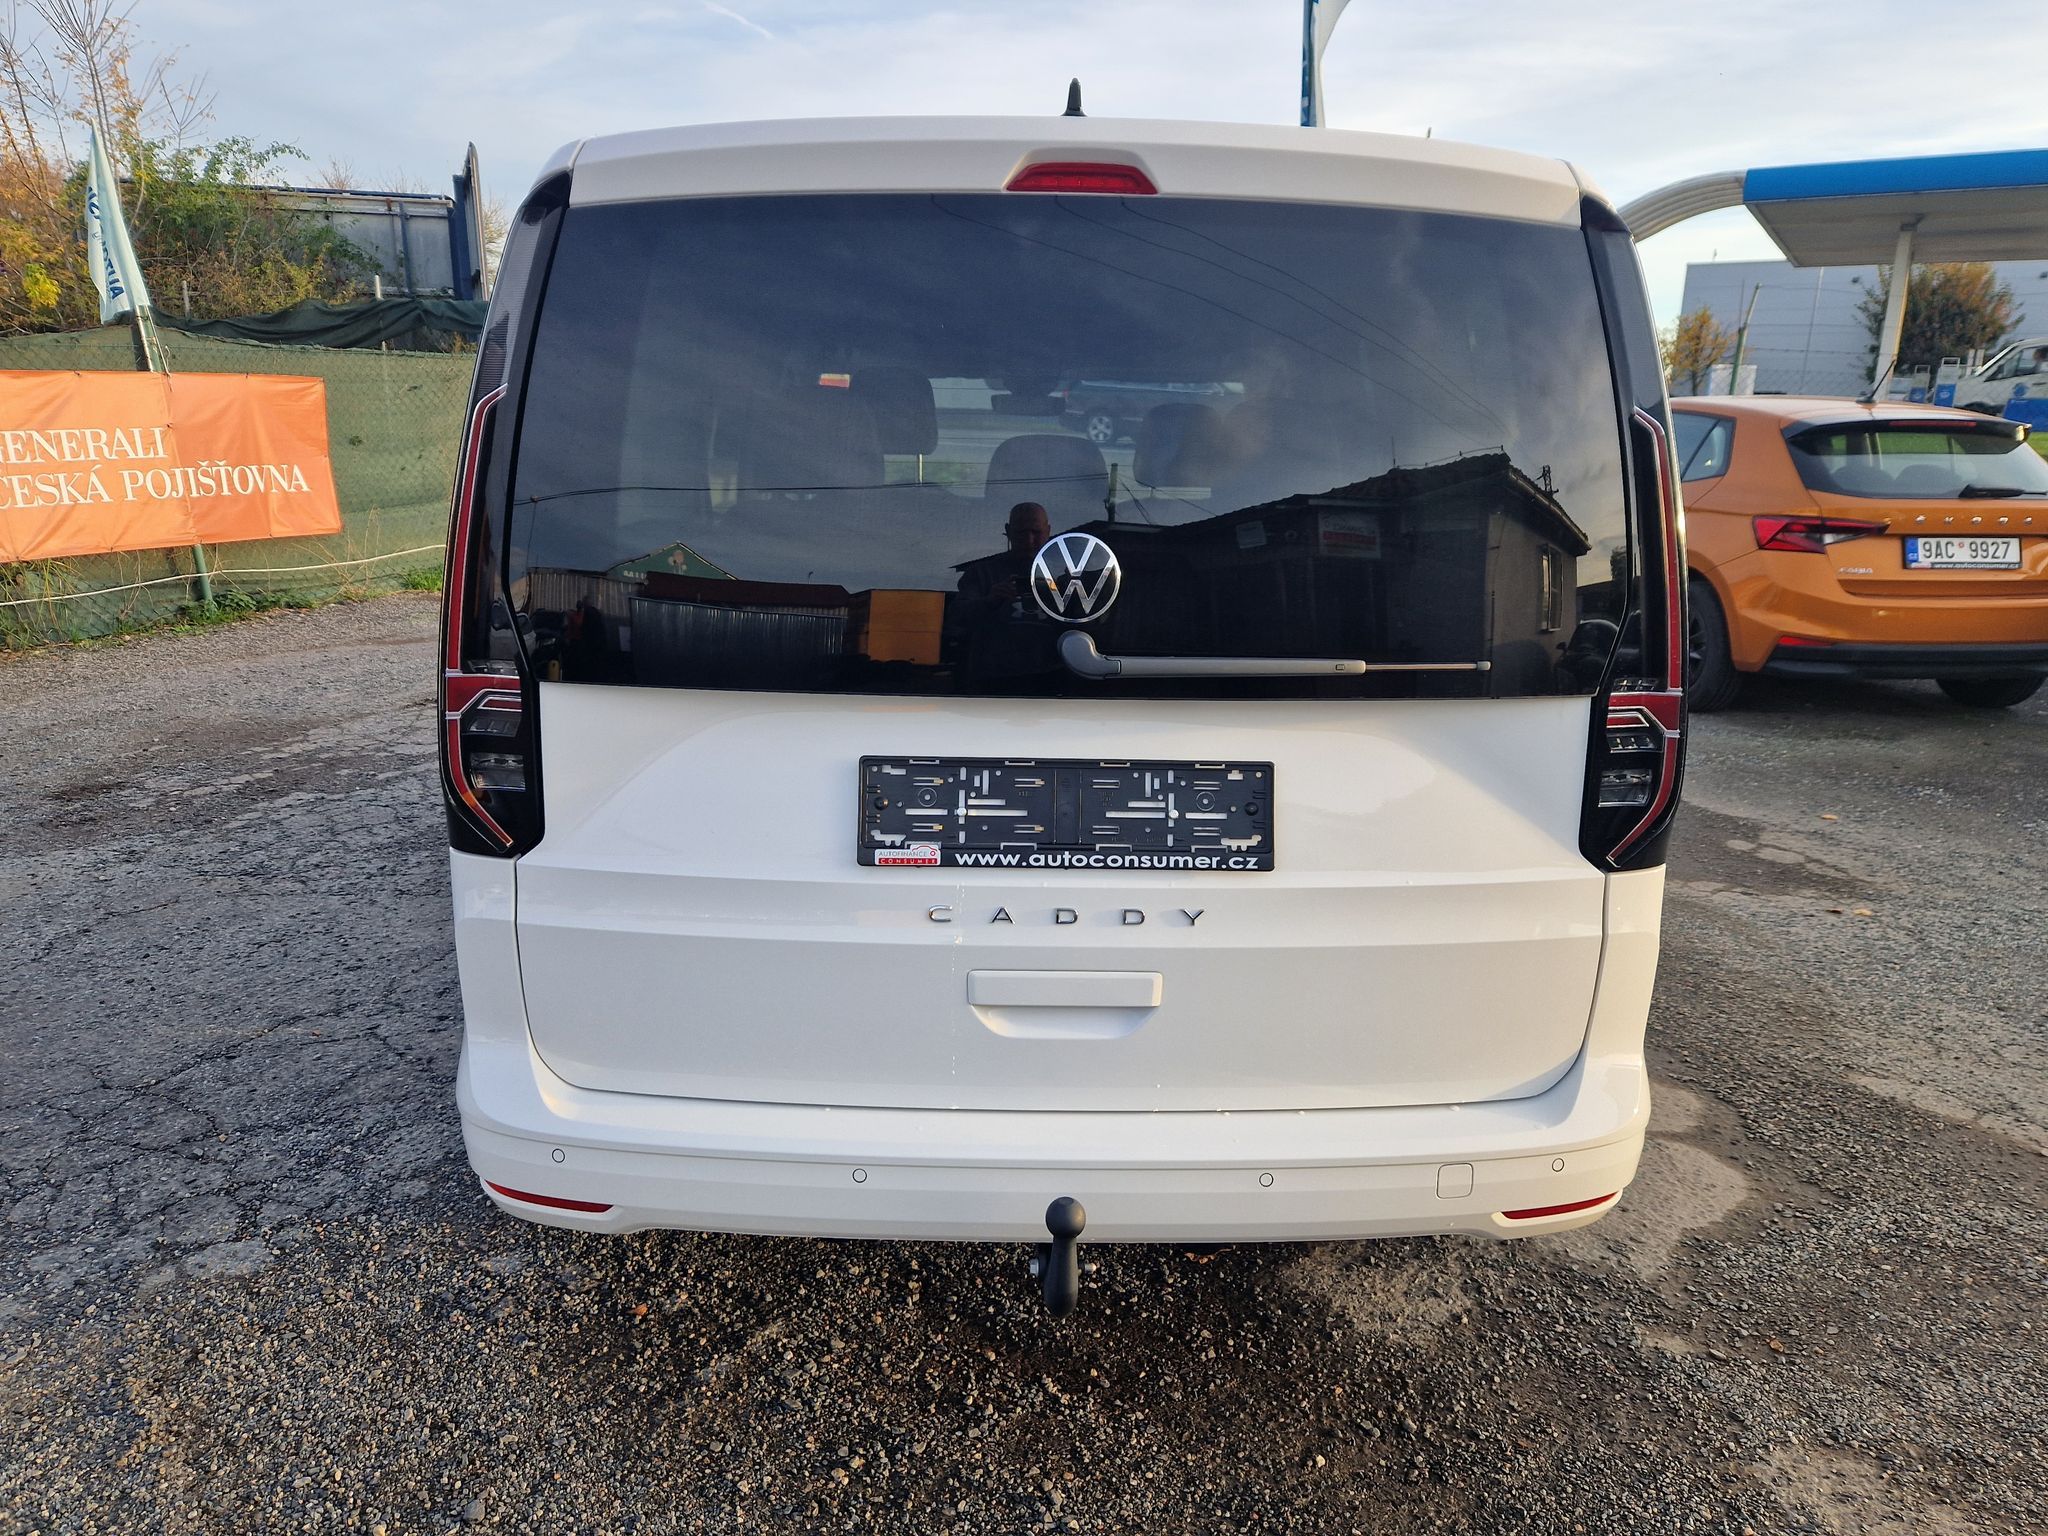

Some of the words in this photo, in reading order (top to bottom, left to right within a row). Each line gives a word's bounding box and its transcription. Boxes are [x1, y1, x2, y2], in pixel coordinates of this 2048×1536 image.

[0, 427, 168, 463] ENERALI
[119, 460, 311, 500] POJIŠŤOVNA
[1922, 541, 1955, 559] 9AC
[1969, 541, 2010, 559] 9927
[955, 850, 1259, 870] www.autoconsumer.cz
[927, 904, 1204, 926] CADDY
